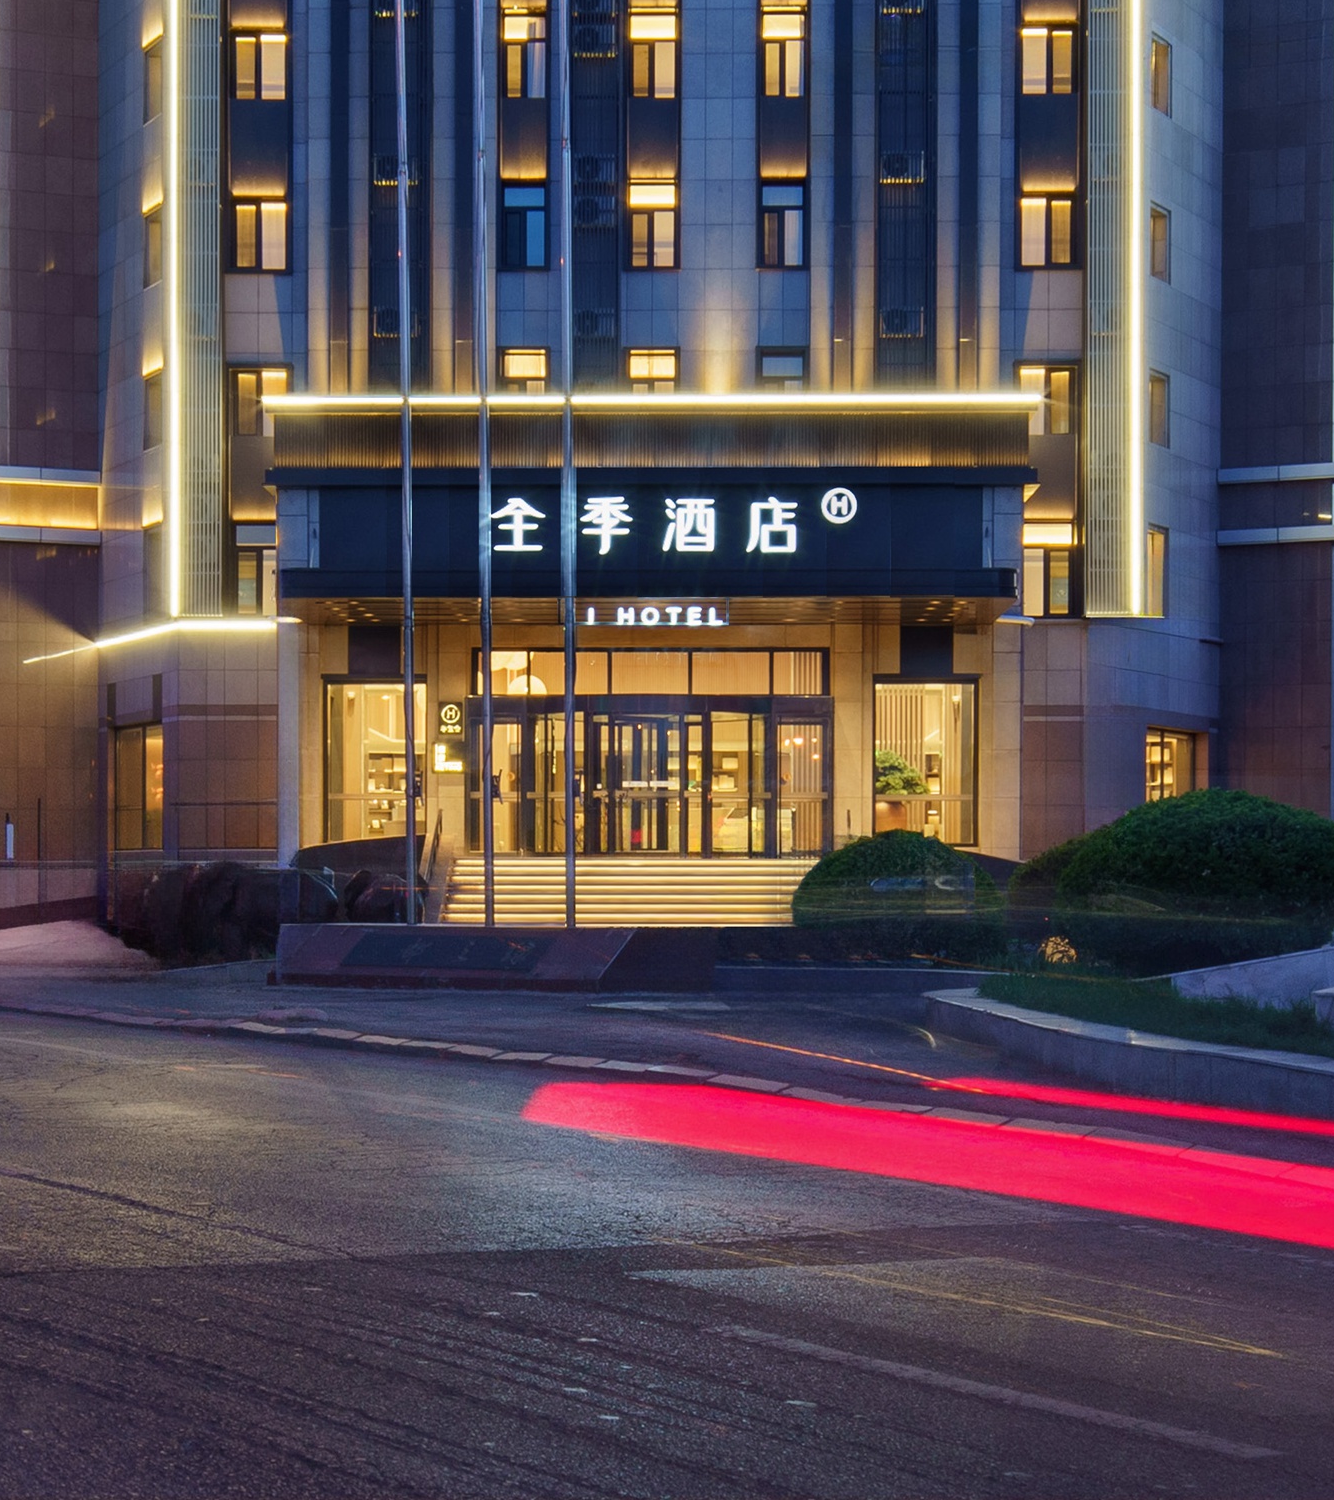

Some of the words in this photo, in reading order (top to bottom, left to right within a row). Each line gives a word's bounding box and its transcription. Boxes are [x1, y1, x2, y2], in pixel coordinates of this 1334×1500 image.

[490, 496, 798, 555] 全季酒店
[617, 606, 724, 626] HOTEL
